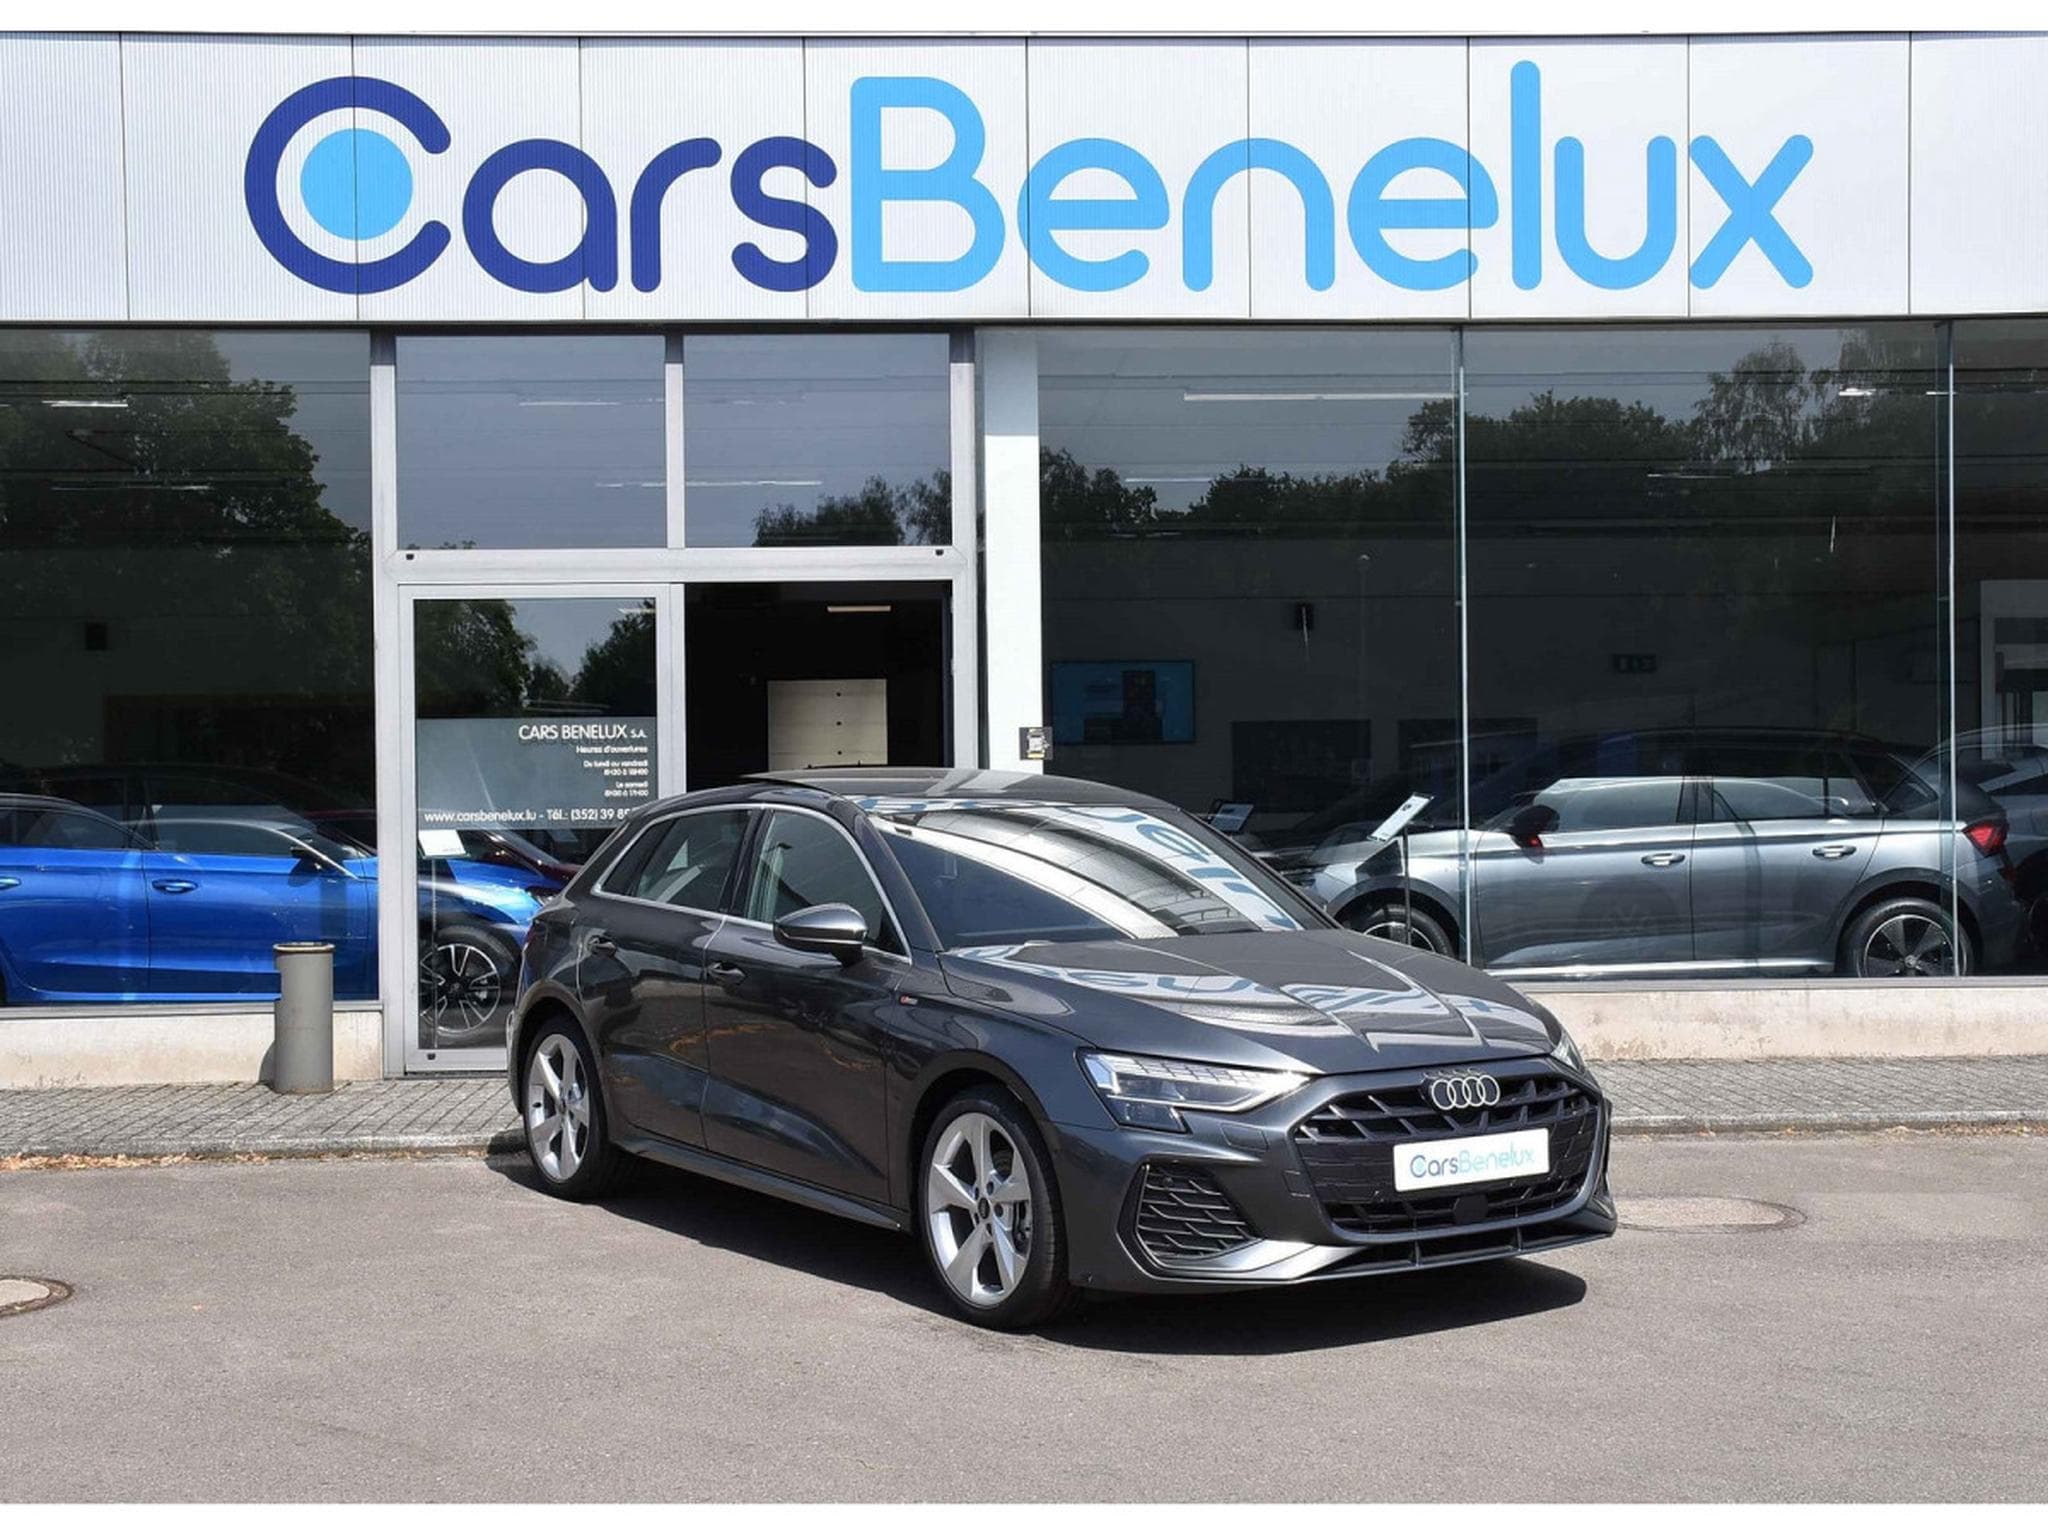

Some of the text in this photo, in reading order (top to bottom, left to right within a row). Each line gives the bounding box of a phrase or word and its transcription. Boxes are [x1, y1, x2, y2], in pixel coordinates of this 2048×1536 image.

[245, 62, 1812, 294] CarsBenelux
[518, 724, 558, 740] CARS
[561, 724, 627, 740] BENELUX
[576, 745, 601, 754] Heures
[424, 809, 537, 822] www.carsbenelux.lu
[571, 808, 598, 822] (352)
[600, 808, 614, 820] 39
[1409, 1142, 1536, 1179] CarsBenelux
